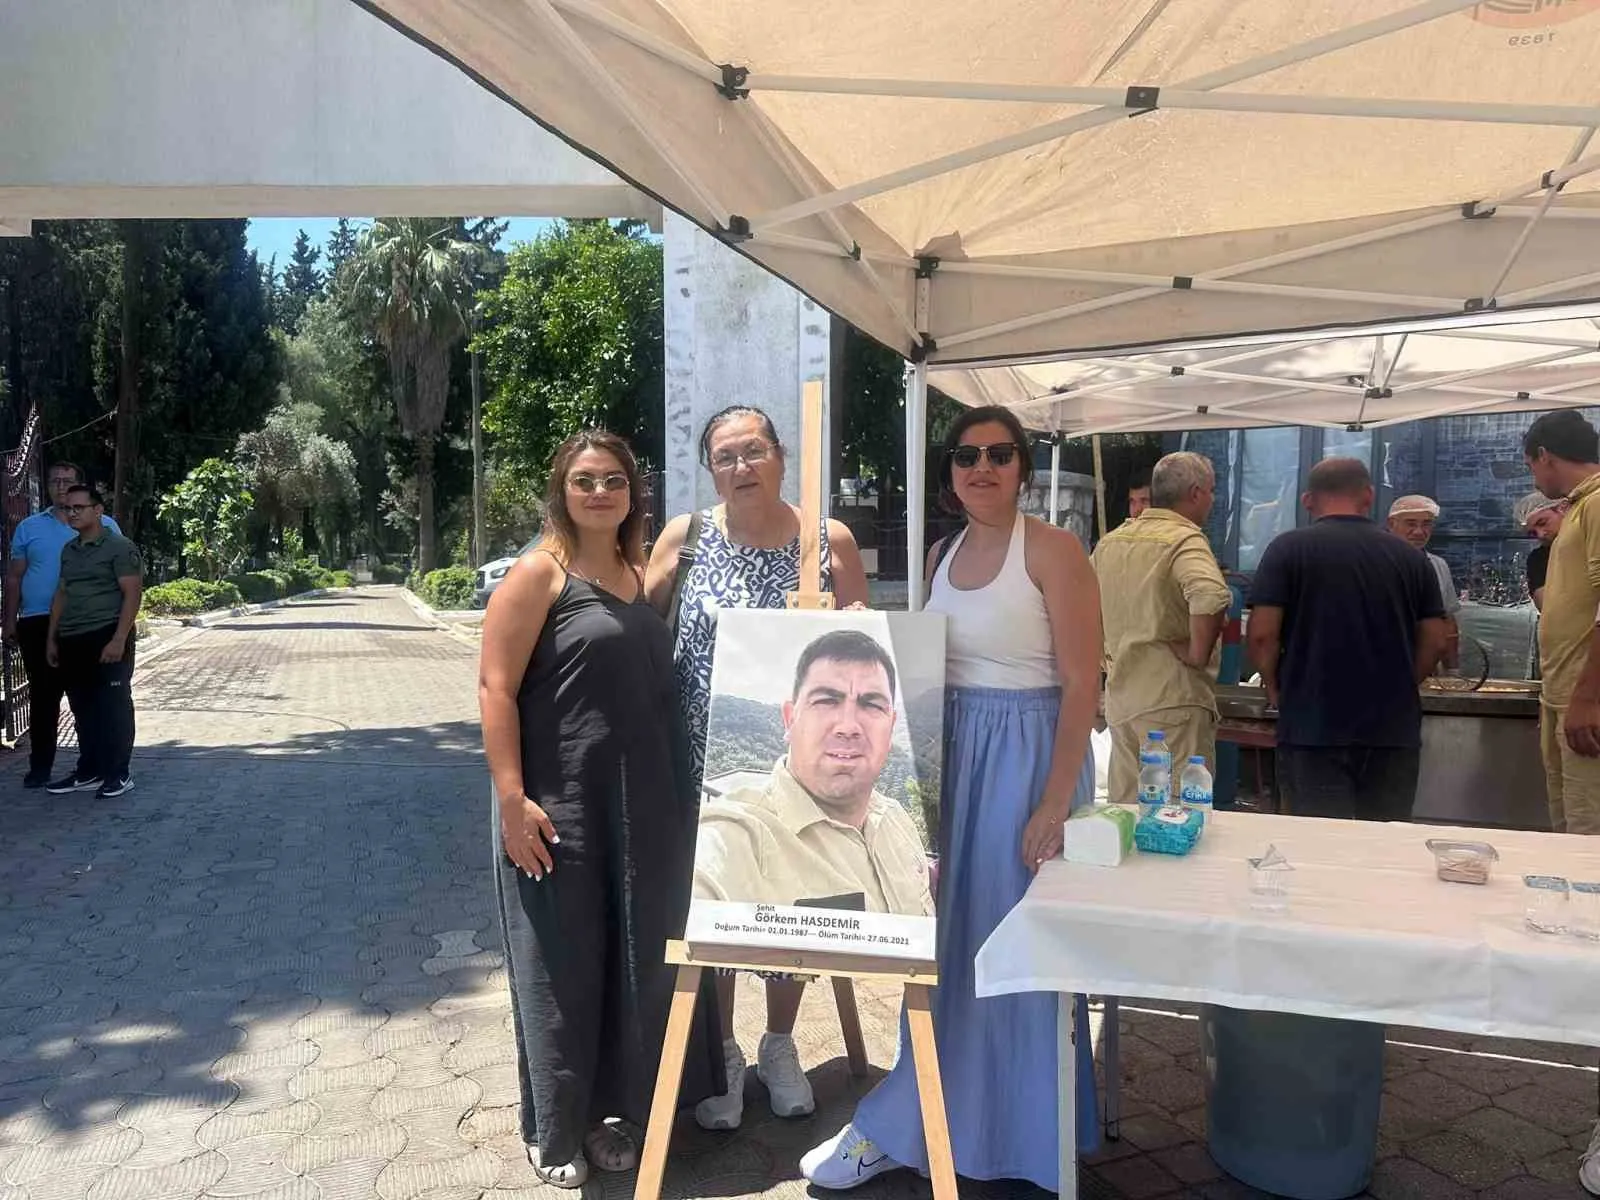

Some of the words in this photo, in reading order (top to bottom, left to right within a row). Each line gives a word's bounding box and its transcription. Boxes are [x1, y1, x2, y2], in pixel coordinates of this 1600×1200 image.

[755, 912, 797, 925] Görkem
[800, 916, 860, 930] HASDEMİR
[714, 922, 740, 932] Doğum
[818, 930, 839, 940] Ölüm
[867, 934, 910, 945] 27.06.2021
